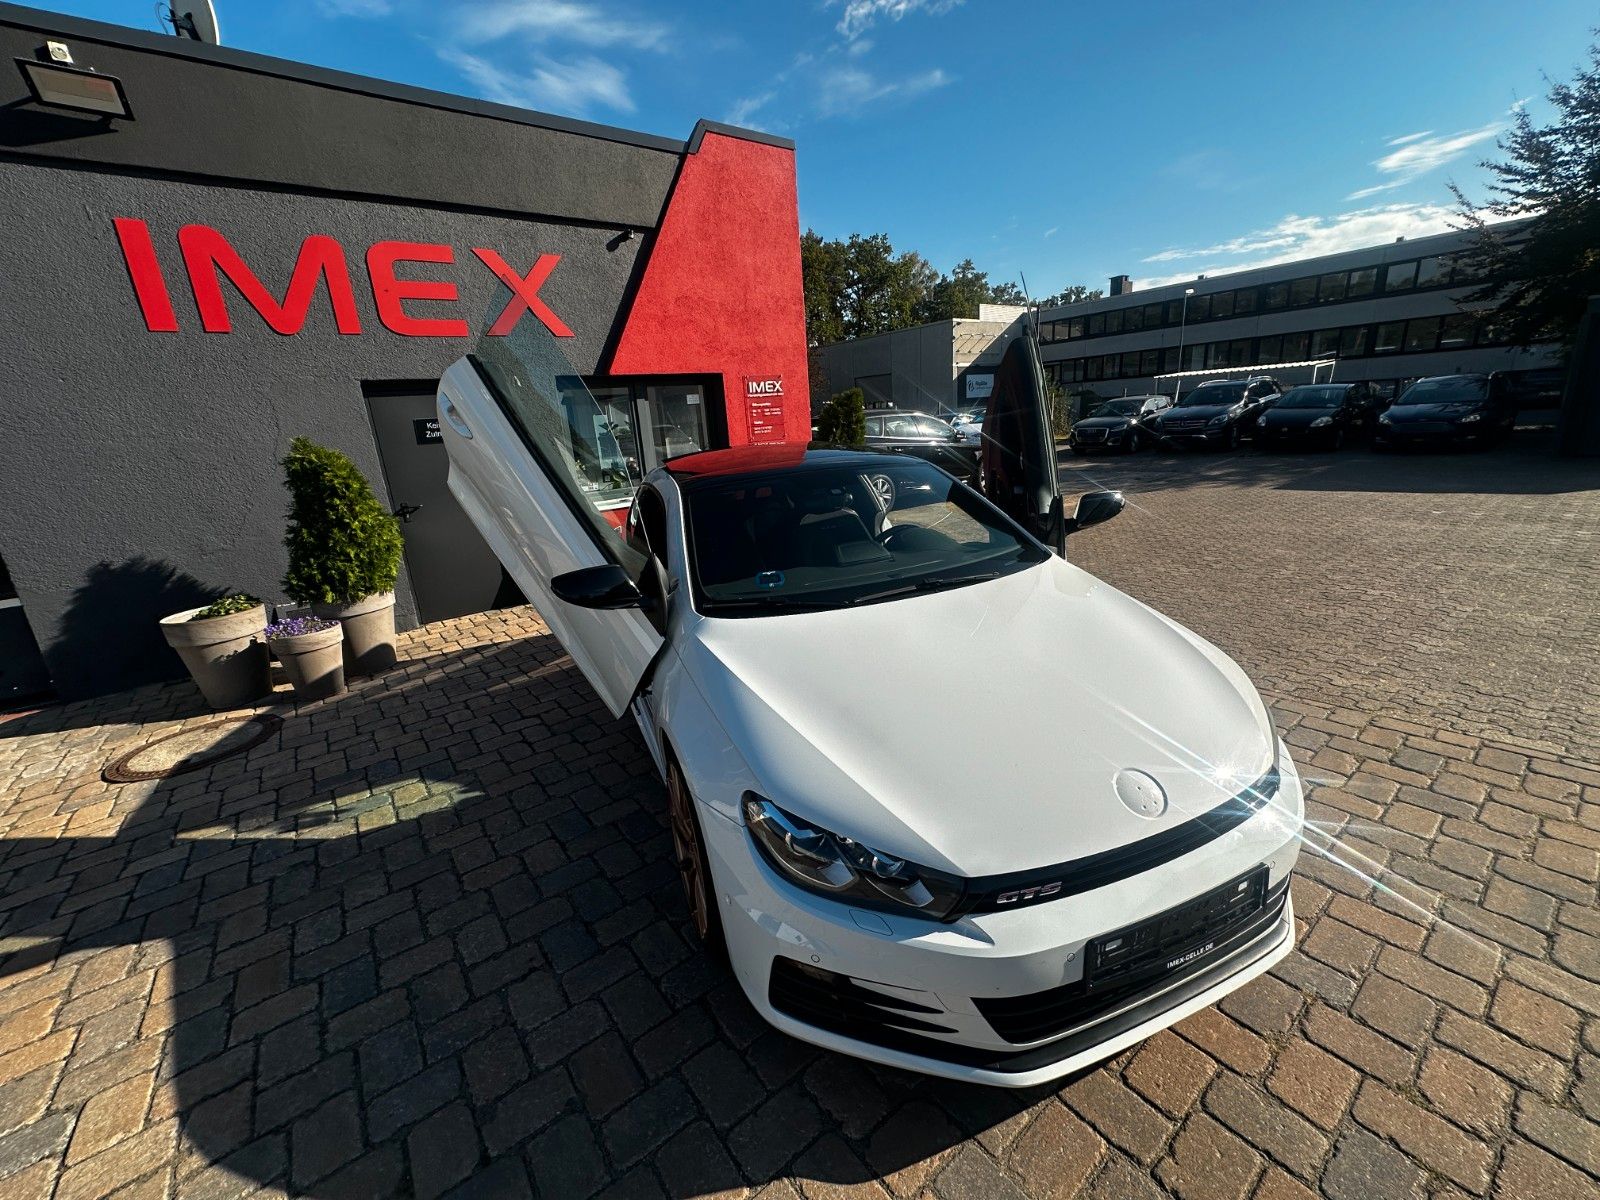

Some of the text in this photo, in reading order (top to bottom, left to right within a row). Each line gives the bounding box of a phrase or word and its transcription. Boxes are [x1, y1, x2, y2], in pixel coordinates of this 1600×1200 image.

[113, 217, 575, 337] IMEX
[748, 380, 783, 393] IMEX
[996, 881, 1063, 904] GTS
[1166, 942, 1214, 969] IMEX-CELLE.DE
